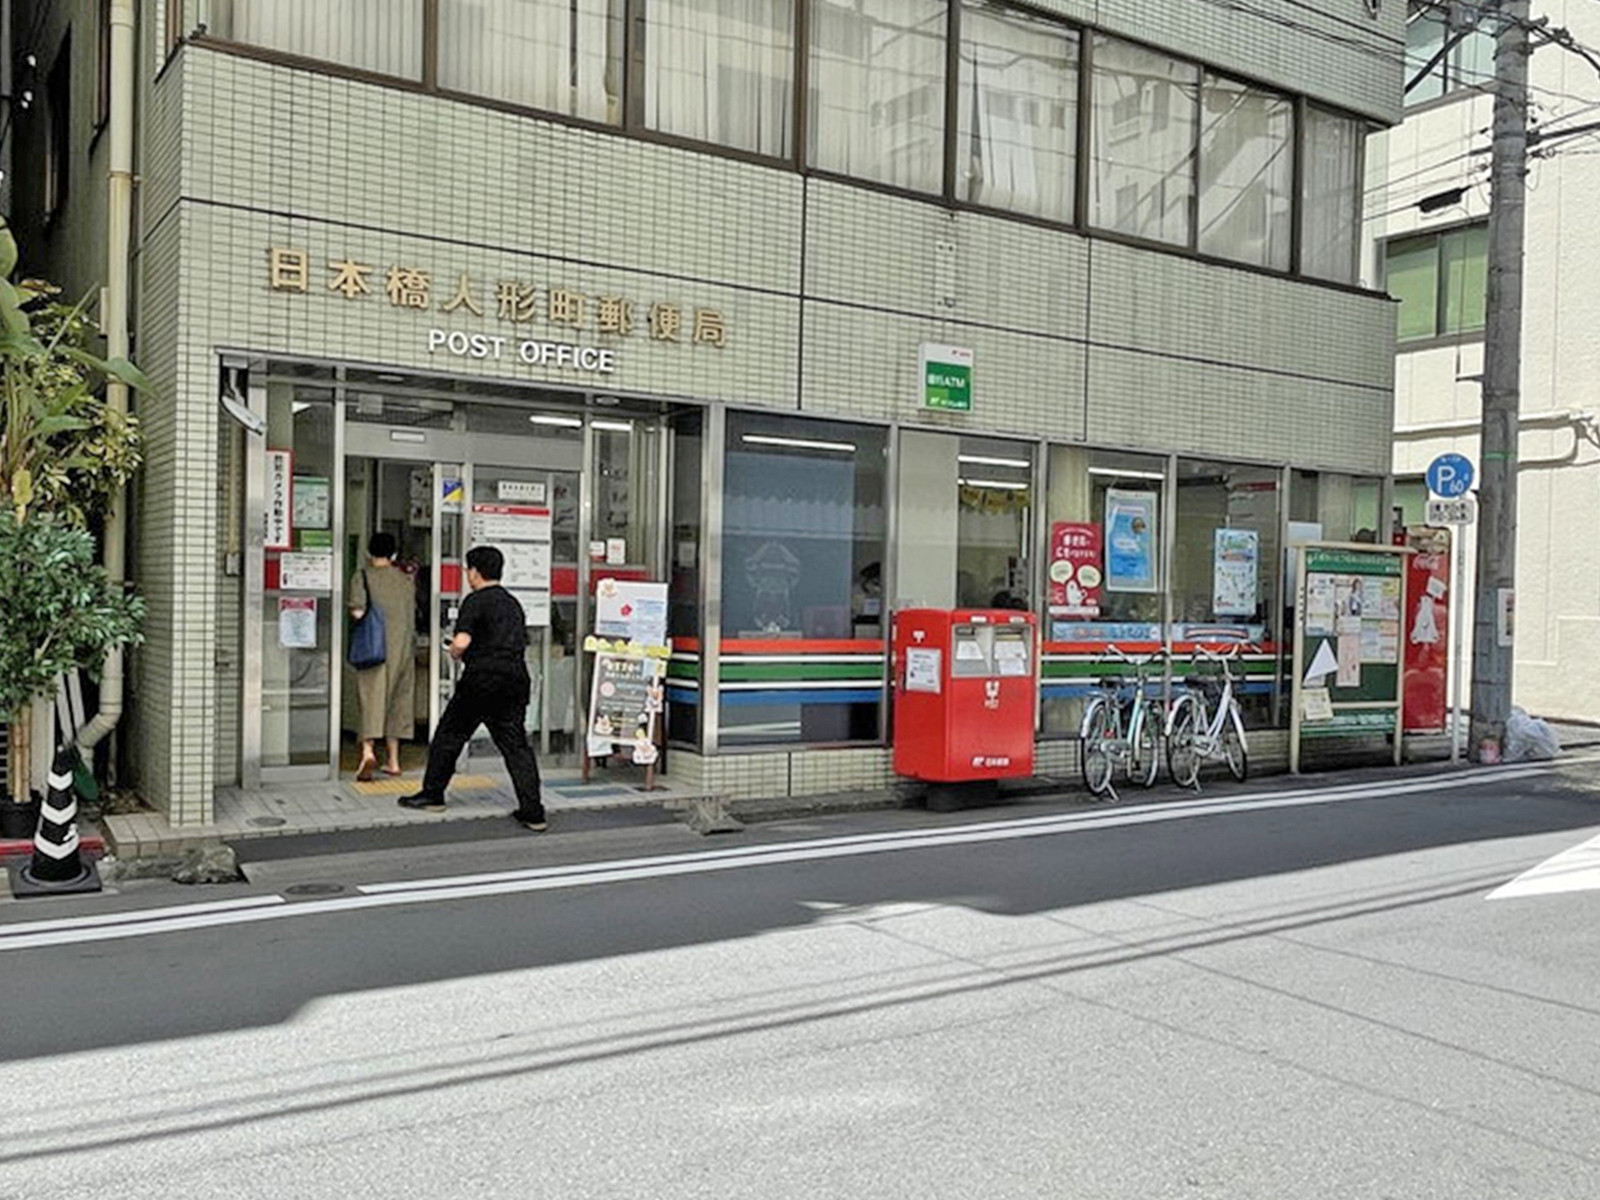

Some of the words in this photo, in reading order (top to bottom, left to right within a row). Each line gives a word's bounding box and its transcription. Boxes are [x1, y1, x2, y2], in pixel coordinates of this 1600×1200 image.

[268, 246, 728, 347] 日本橋人形町郵便局
[428, 328, 506, 359] POST
[519, 340, 616, 373] OFFICE
[1437, 465, 1456, 493] P
